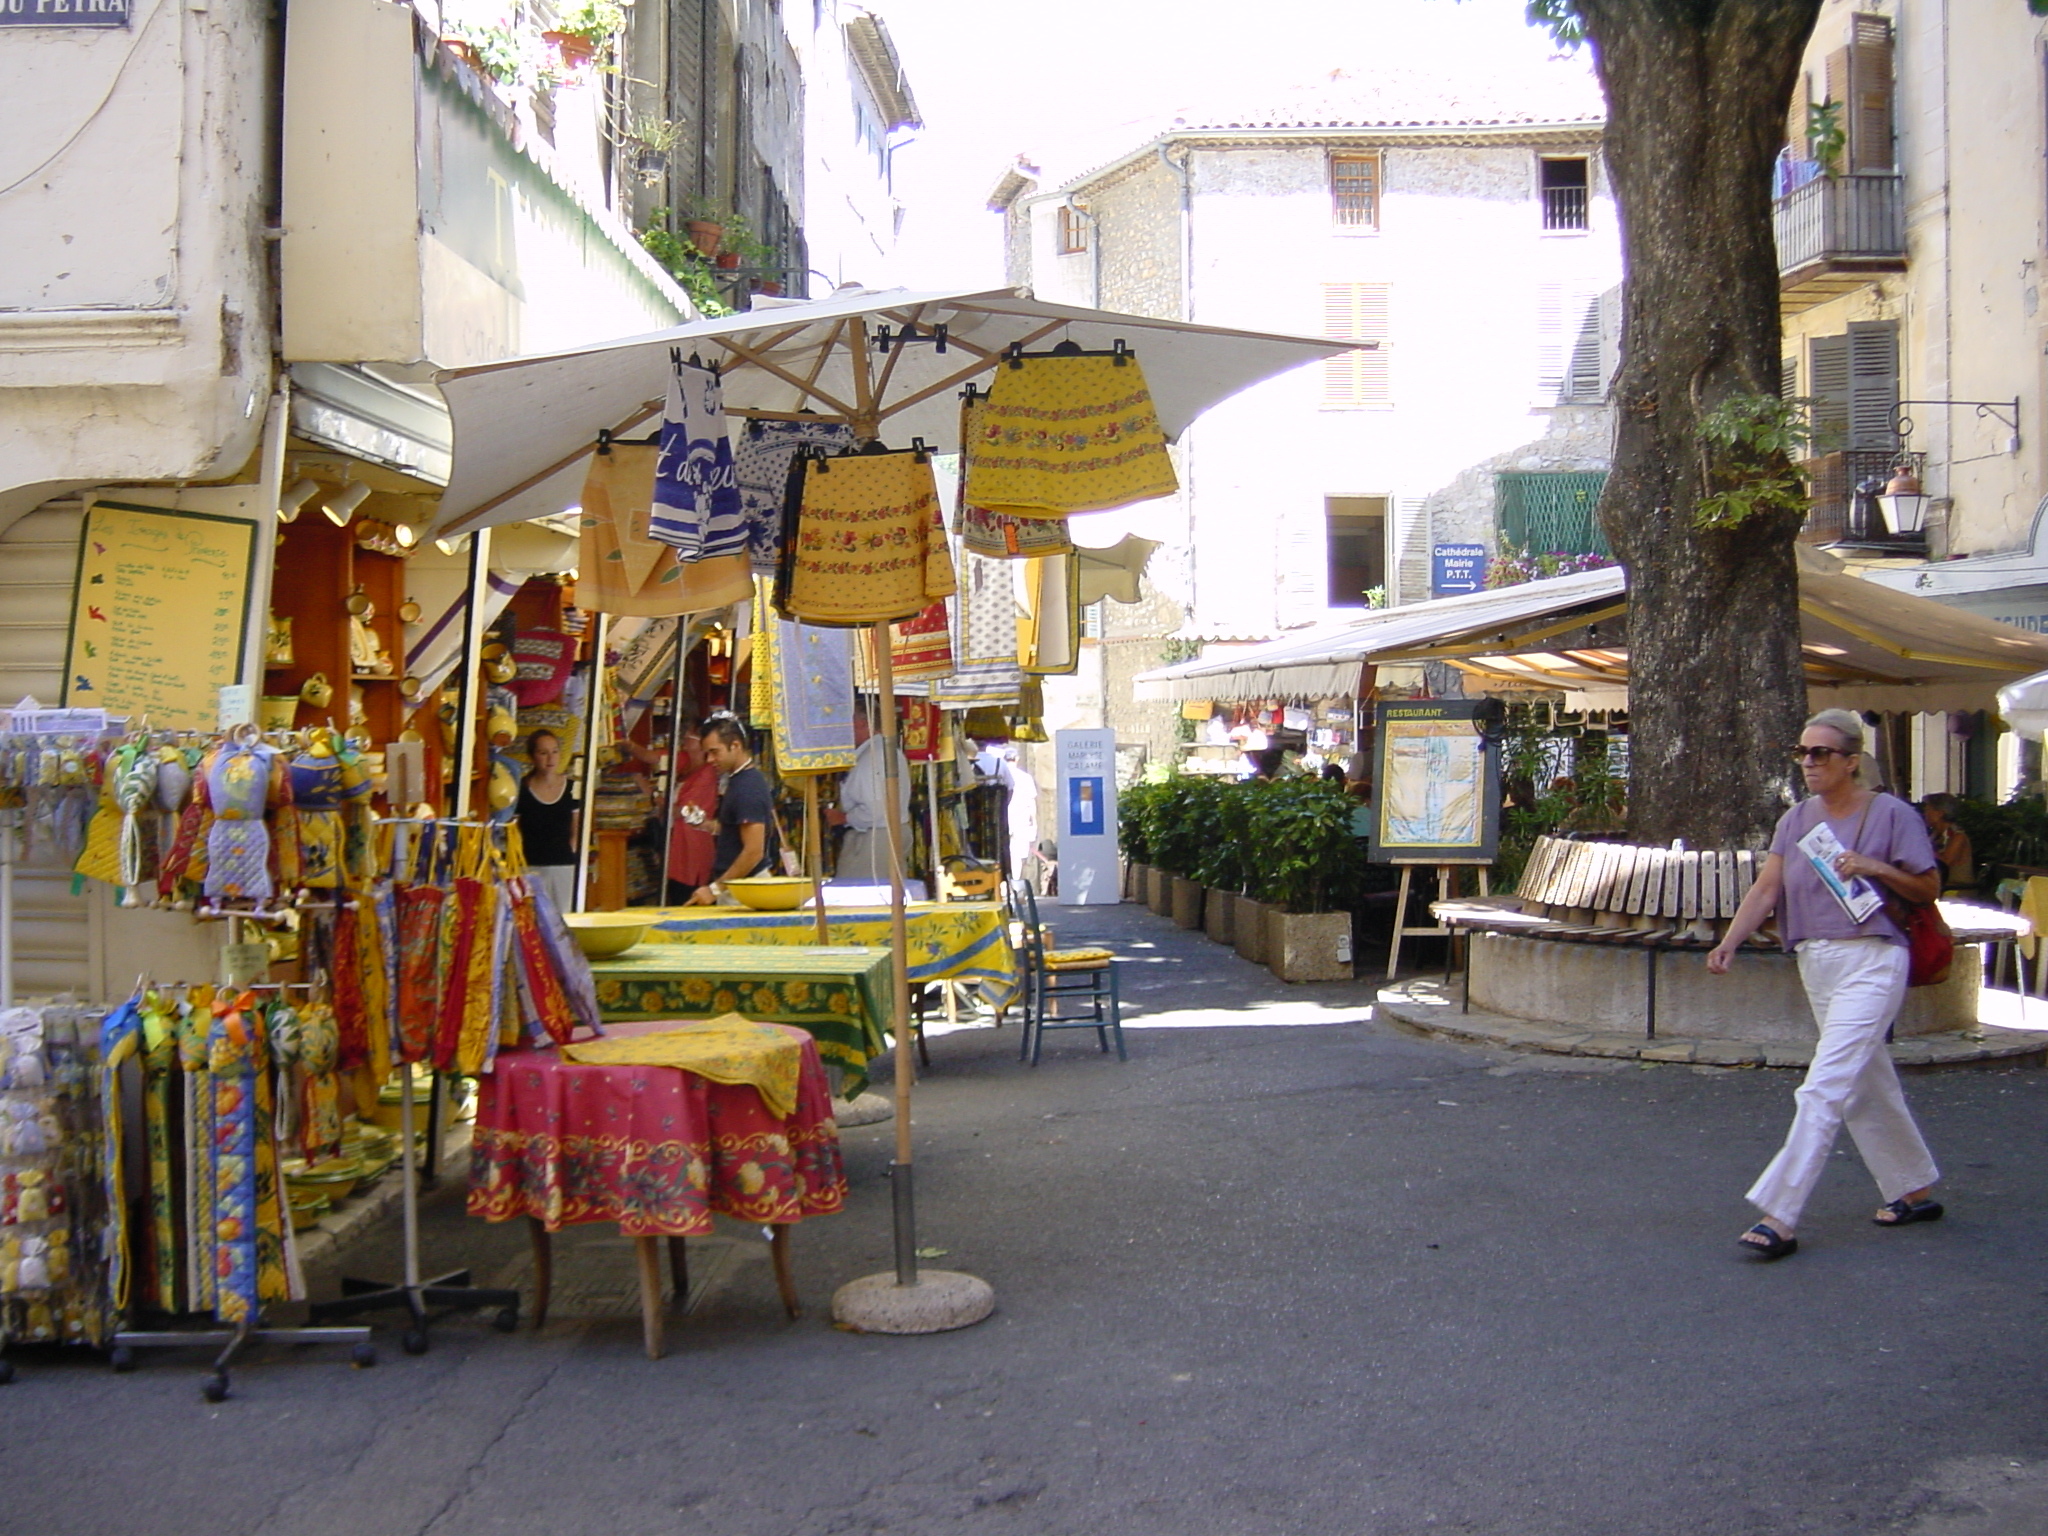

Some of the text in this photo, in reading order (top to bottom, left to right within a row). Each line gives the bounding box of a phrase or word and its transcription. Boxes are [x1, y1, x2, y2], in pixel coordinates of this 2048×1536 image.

[1434, 547, 1484, 557] Cathédrale
[1444, 558, 1474, 568] Mairie
[1446, 569, 1472, 579] P.T.T.
[1386, 708, 1443, 718] RESTAURANT
[1067, 740, 1103, 750] GALERIE
